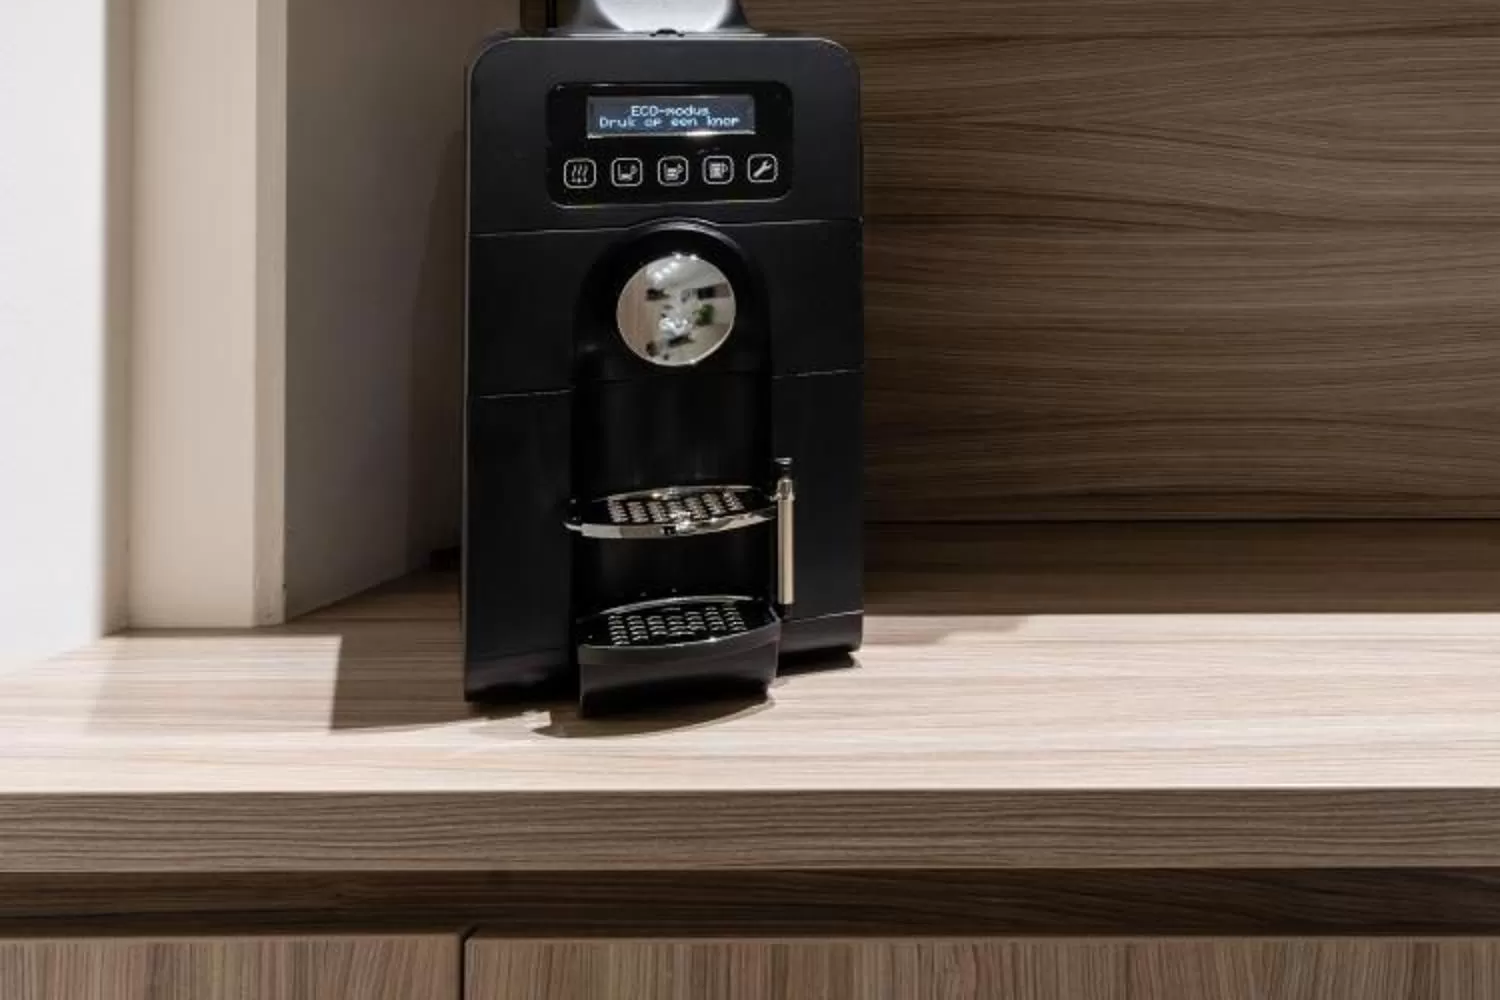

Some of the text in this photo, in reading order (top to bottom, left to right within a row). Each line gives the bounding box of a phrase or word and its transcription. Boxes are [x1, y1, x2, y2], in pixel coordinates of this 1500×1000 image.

[630, 104, 711, 117] ECO-modus
[599, 116, 636, 129] Druk
[671, 116, 698, 127] een
